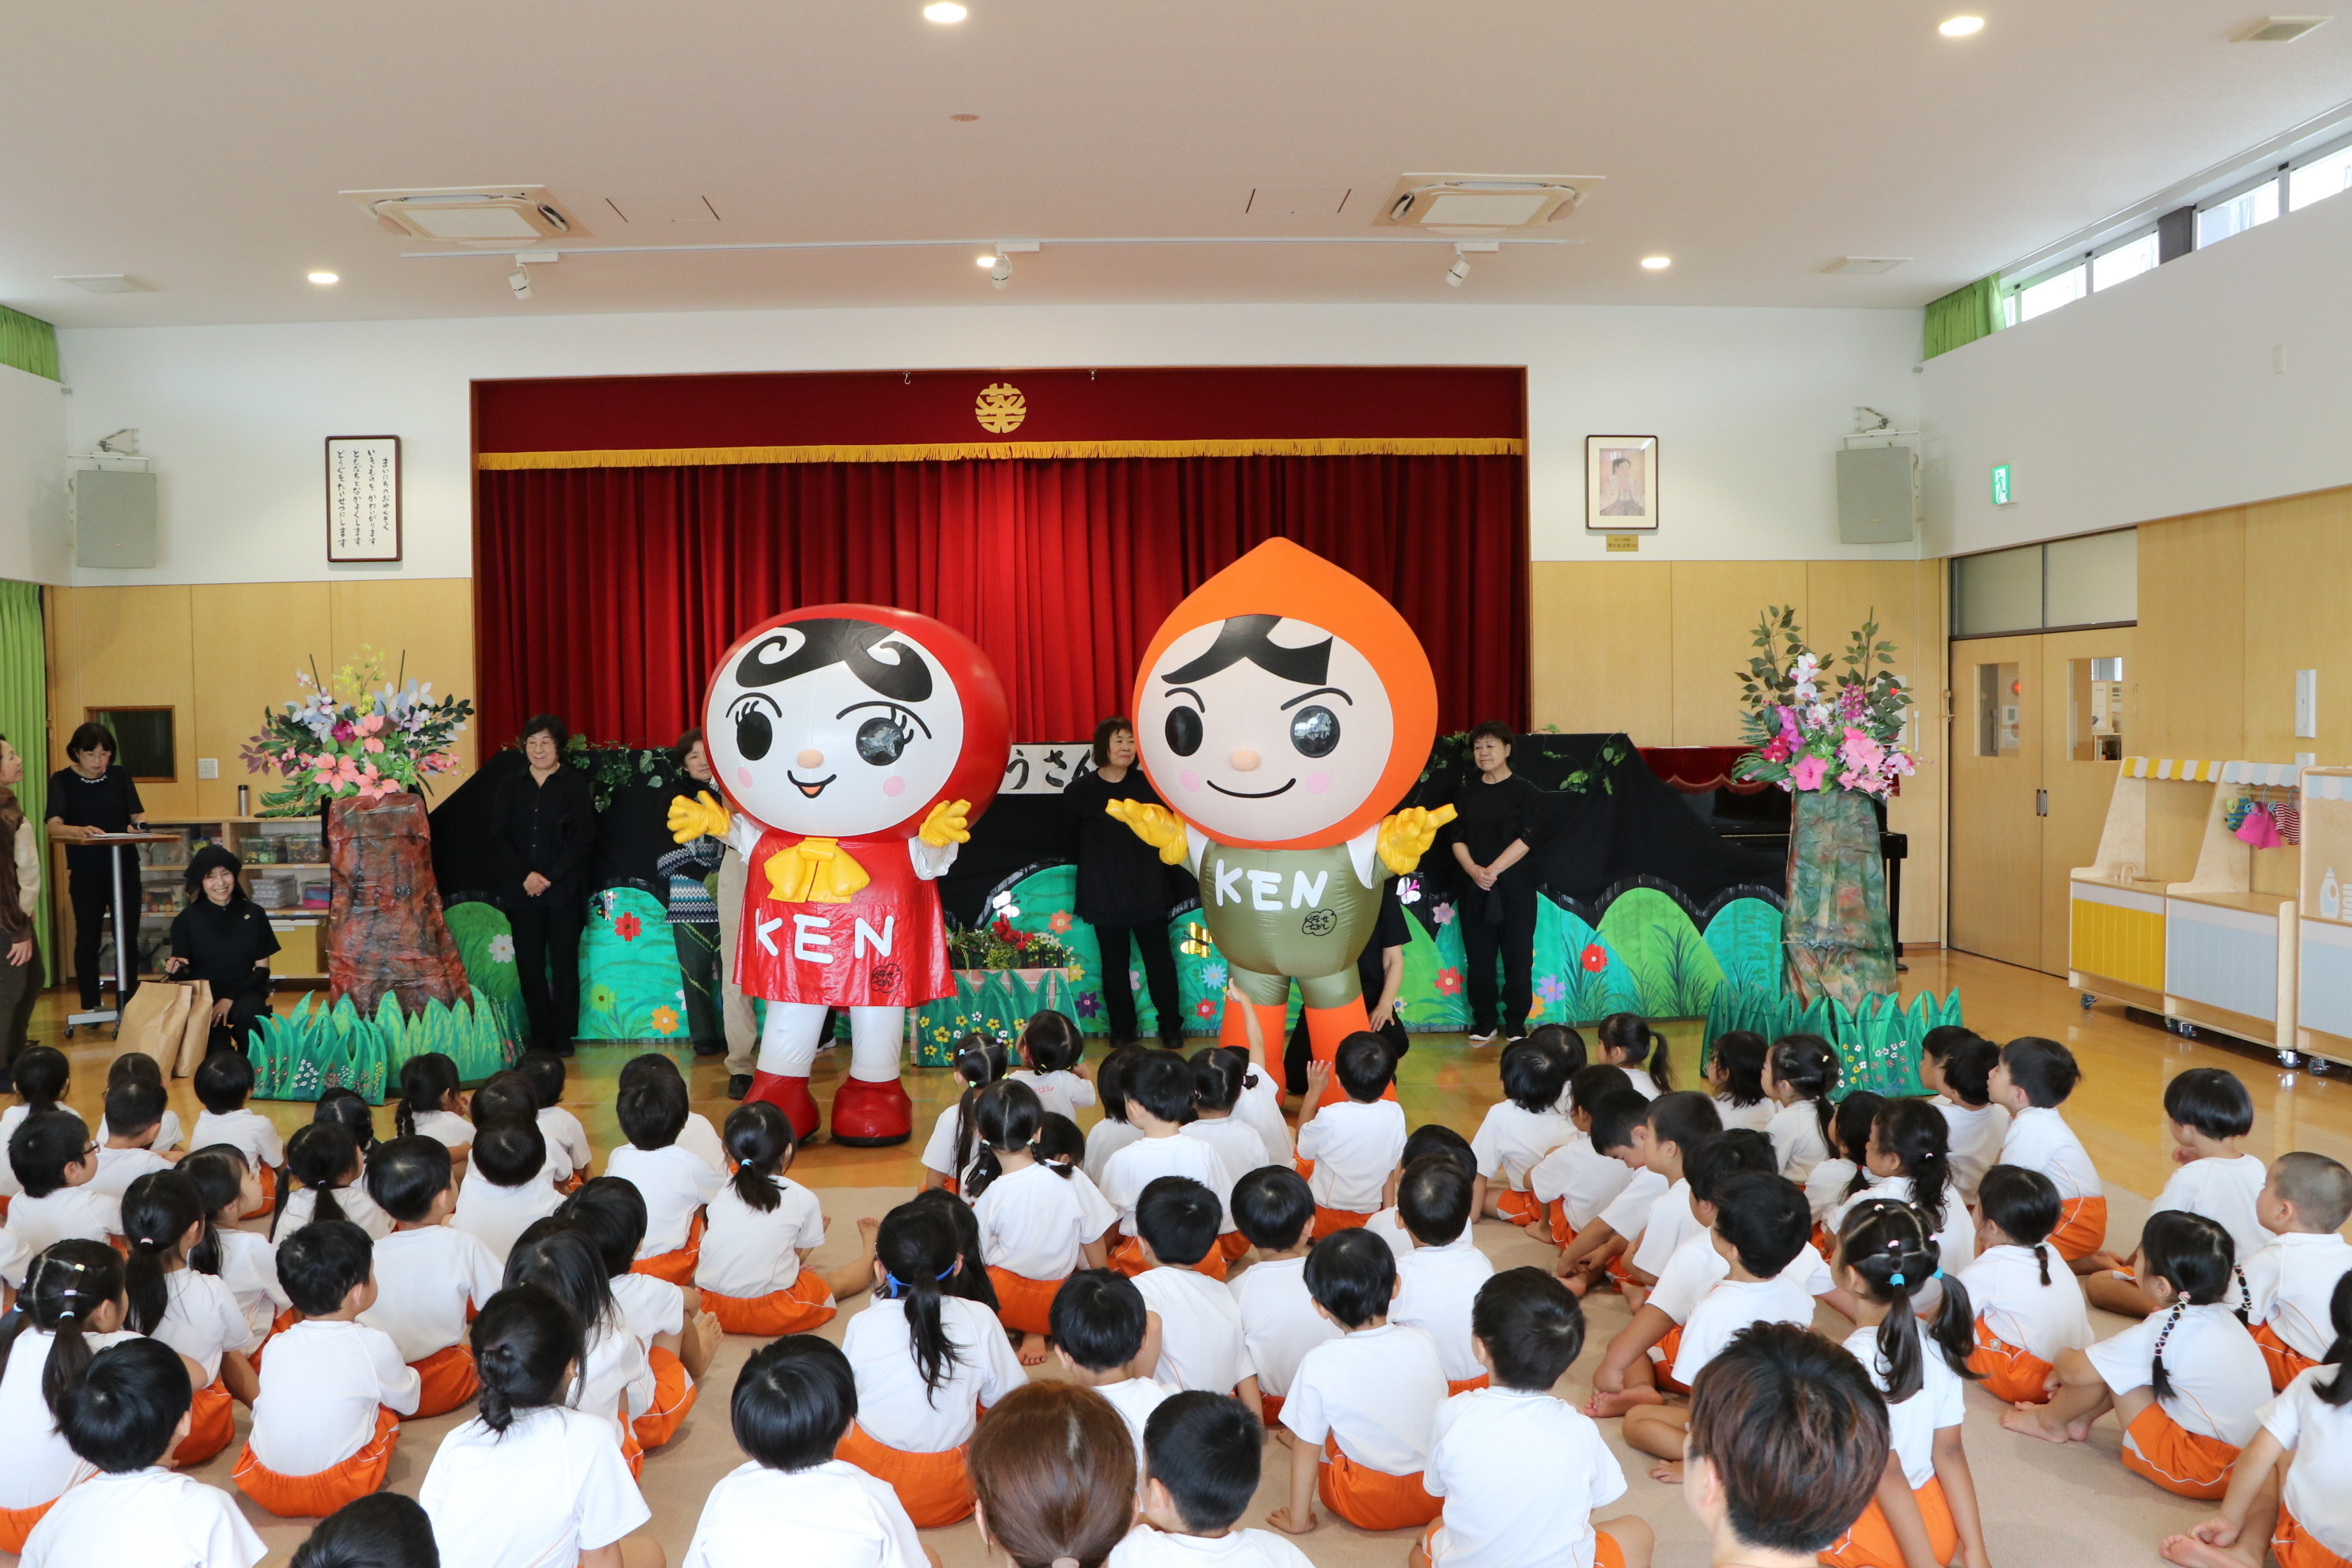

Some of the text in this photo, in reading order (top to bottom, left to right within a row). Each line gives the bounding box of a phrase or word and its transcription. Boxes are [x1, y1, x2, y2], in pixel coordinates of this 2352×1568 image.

[337, 450, 347, 548] どうぐをたいせつにします
[1215, 858, 1329, 910] KEN
[755, 908, 895, 964] KEN
